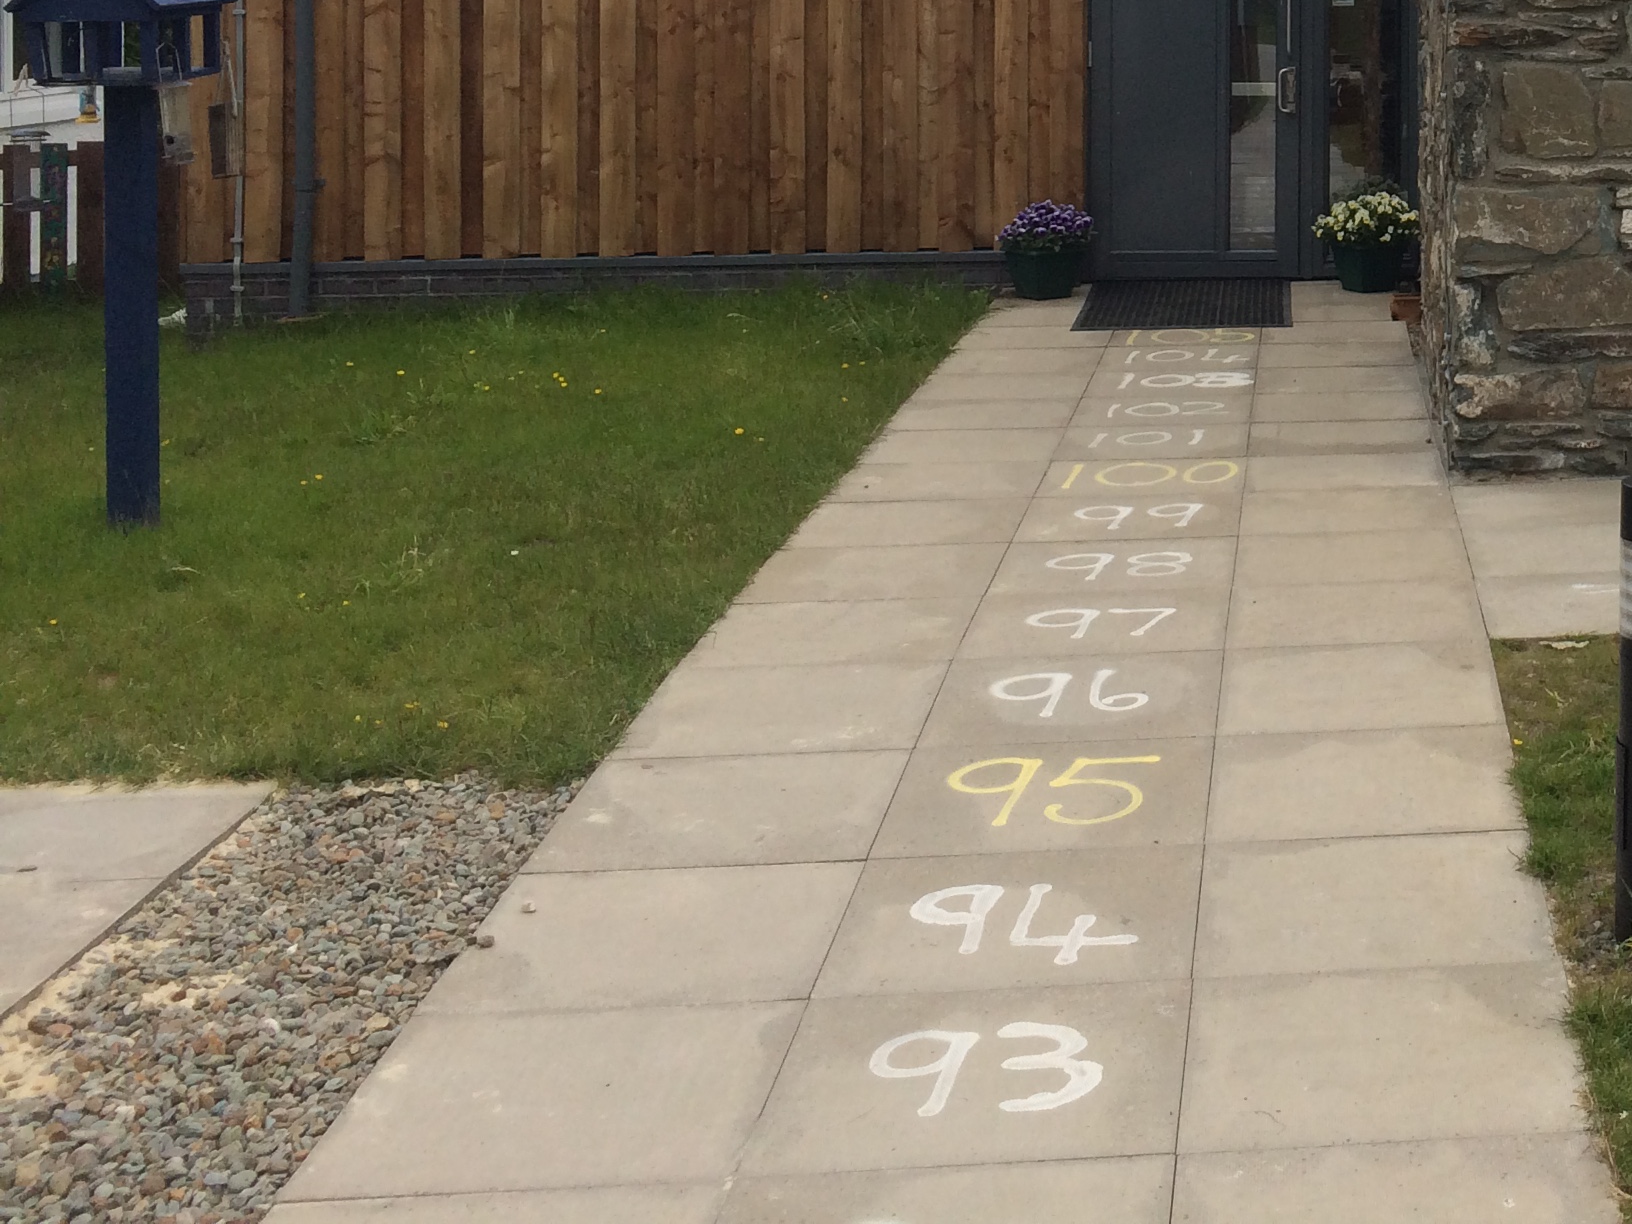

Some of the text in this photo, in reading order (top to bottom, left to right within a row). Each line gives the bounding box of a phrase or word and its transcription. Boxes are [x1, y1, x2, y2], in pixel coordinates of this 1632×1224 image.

[1124, 348, 1250, 364] 104
[1107, 401, 1229, 417] 102
[1088, 428, 1204, 448] 101
[1061, 460, 1239, 489] 100
[1074, 503, 1204, 530] 99
[1045, 551, 1193, 580] 98
[1025, 608, 1177, 639] 97
[989, 669, 1149, 717] 96
[947, 755, 1162, 827] 95
[909, 882, 1139, 965] 94
[869, 1021, 1104, 1117] 93
